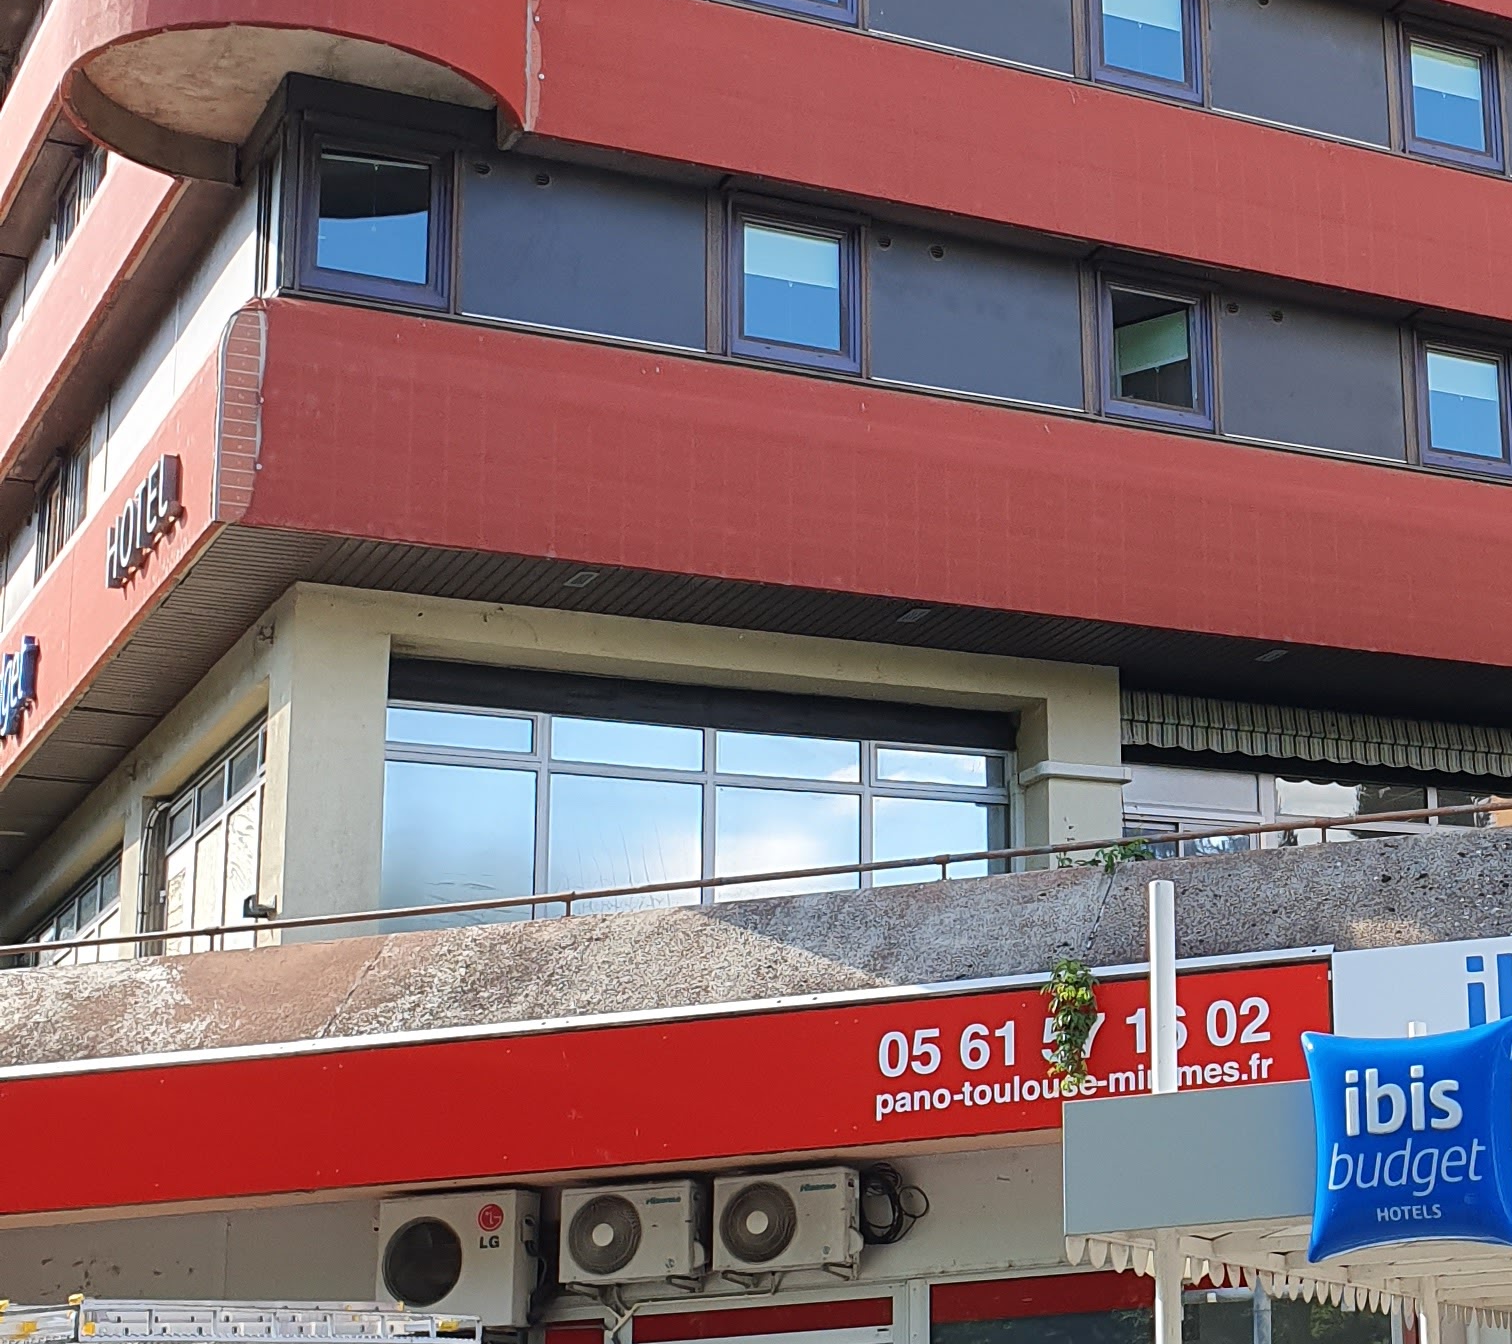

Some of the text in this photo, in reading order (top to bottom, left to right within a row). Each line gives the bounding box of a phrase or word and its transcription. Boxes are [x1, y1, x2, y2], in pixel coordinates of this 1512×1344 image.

[106, 454, 180, 588] HOTEL
[878, 1027, 942, 1078] 05
[959, 1020, 1016, 1070] 61
[1206, 996, 1271, 1046] 02
[875, 1052, 1274, 1121] pano-toulouse-mimes.fr
[1345, 1064, 1463, 1137] ibis
[1328, 1137, 1486, 1197] budget
[479, 1235, 500, 1249] LG
[1377, 1204, 1442, 1222] HOTELS
